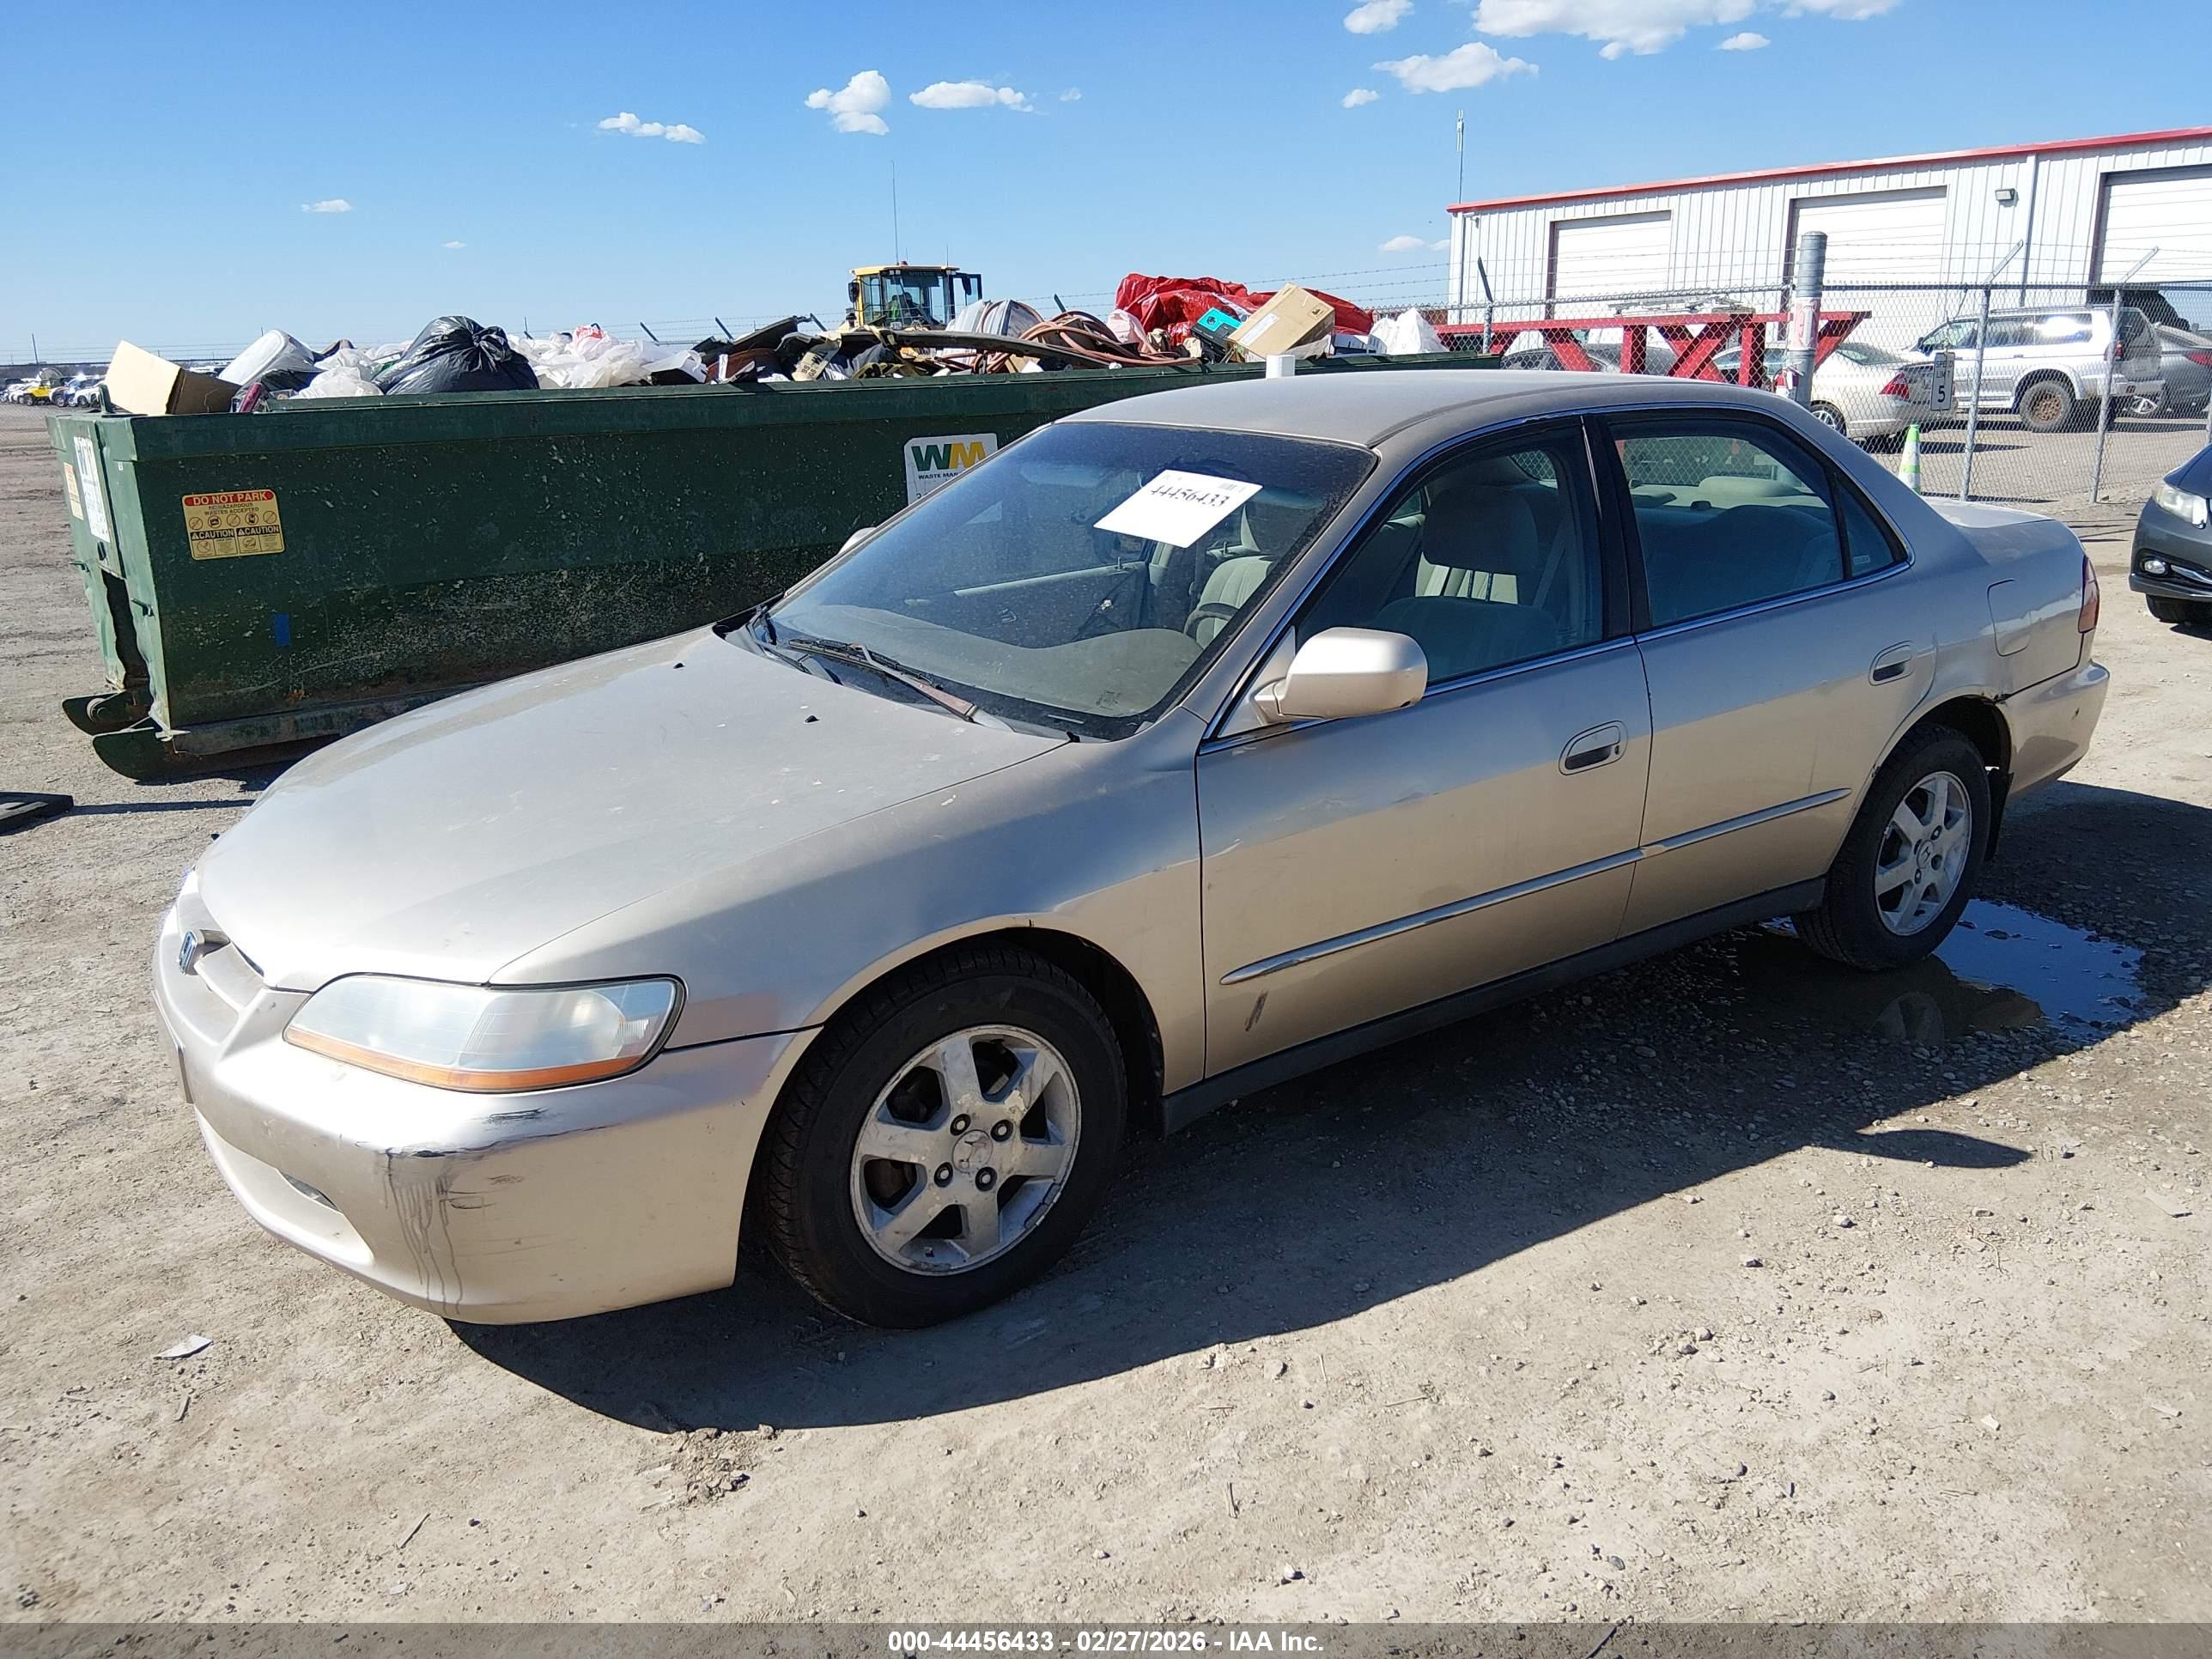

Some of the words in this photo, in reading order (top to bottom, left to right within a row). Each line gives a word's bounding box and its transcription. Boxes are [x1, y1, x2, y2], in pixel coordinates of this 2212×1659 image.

[1937, 385, 1946, 403] 5
[911, 441, 987, 472] WM
[193, 496, 210, 506] DO
[212, 494, 234, 504] NOT
[238, 492, 268, 502] PARK
[198, 529, 234, 539] CAUTION
[245, 526, 279, 536] CAUTION
